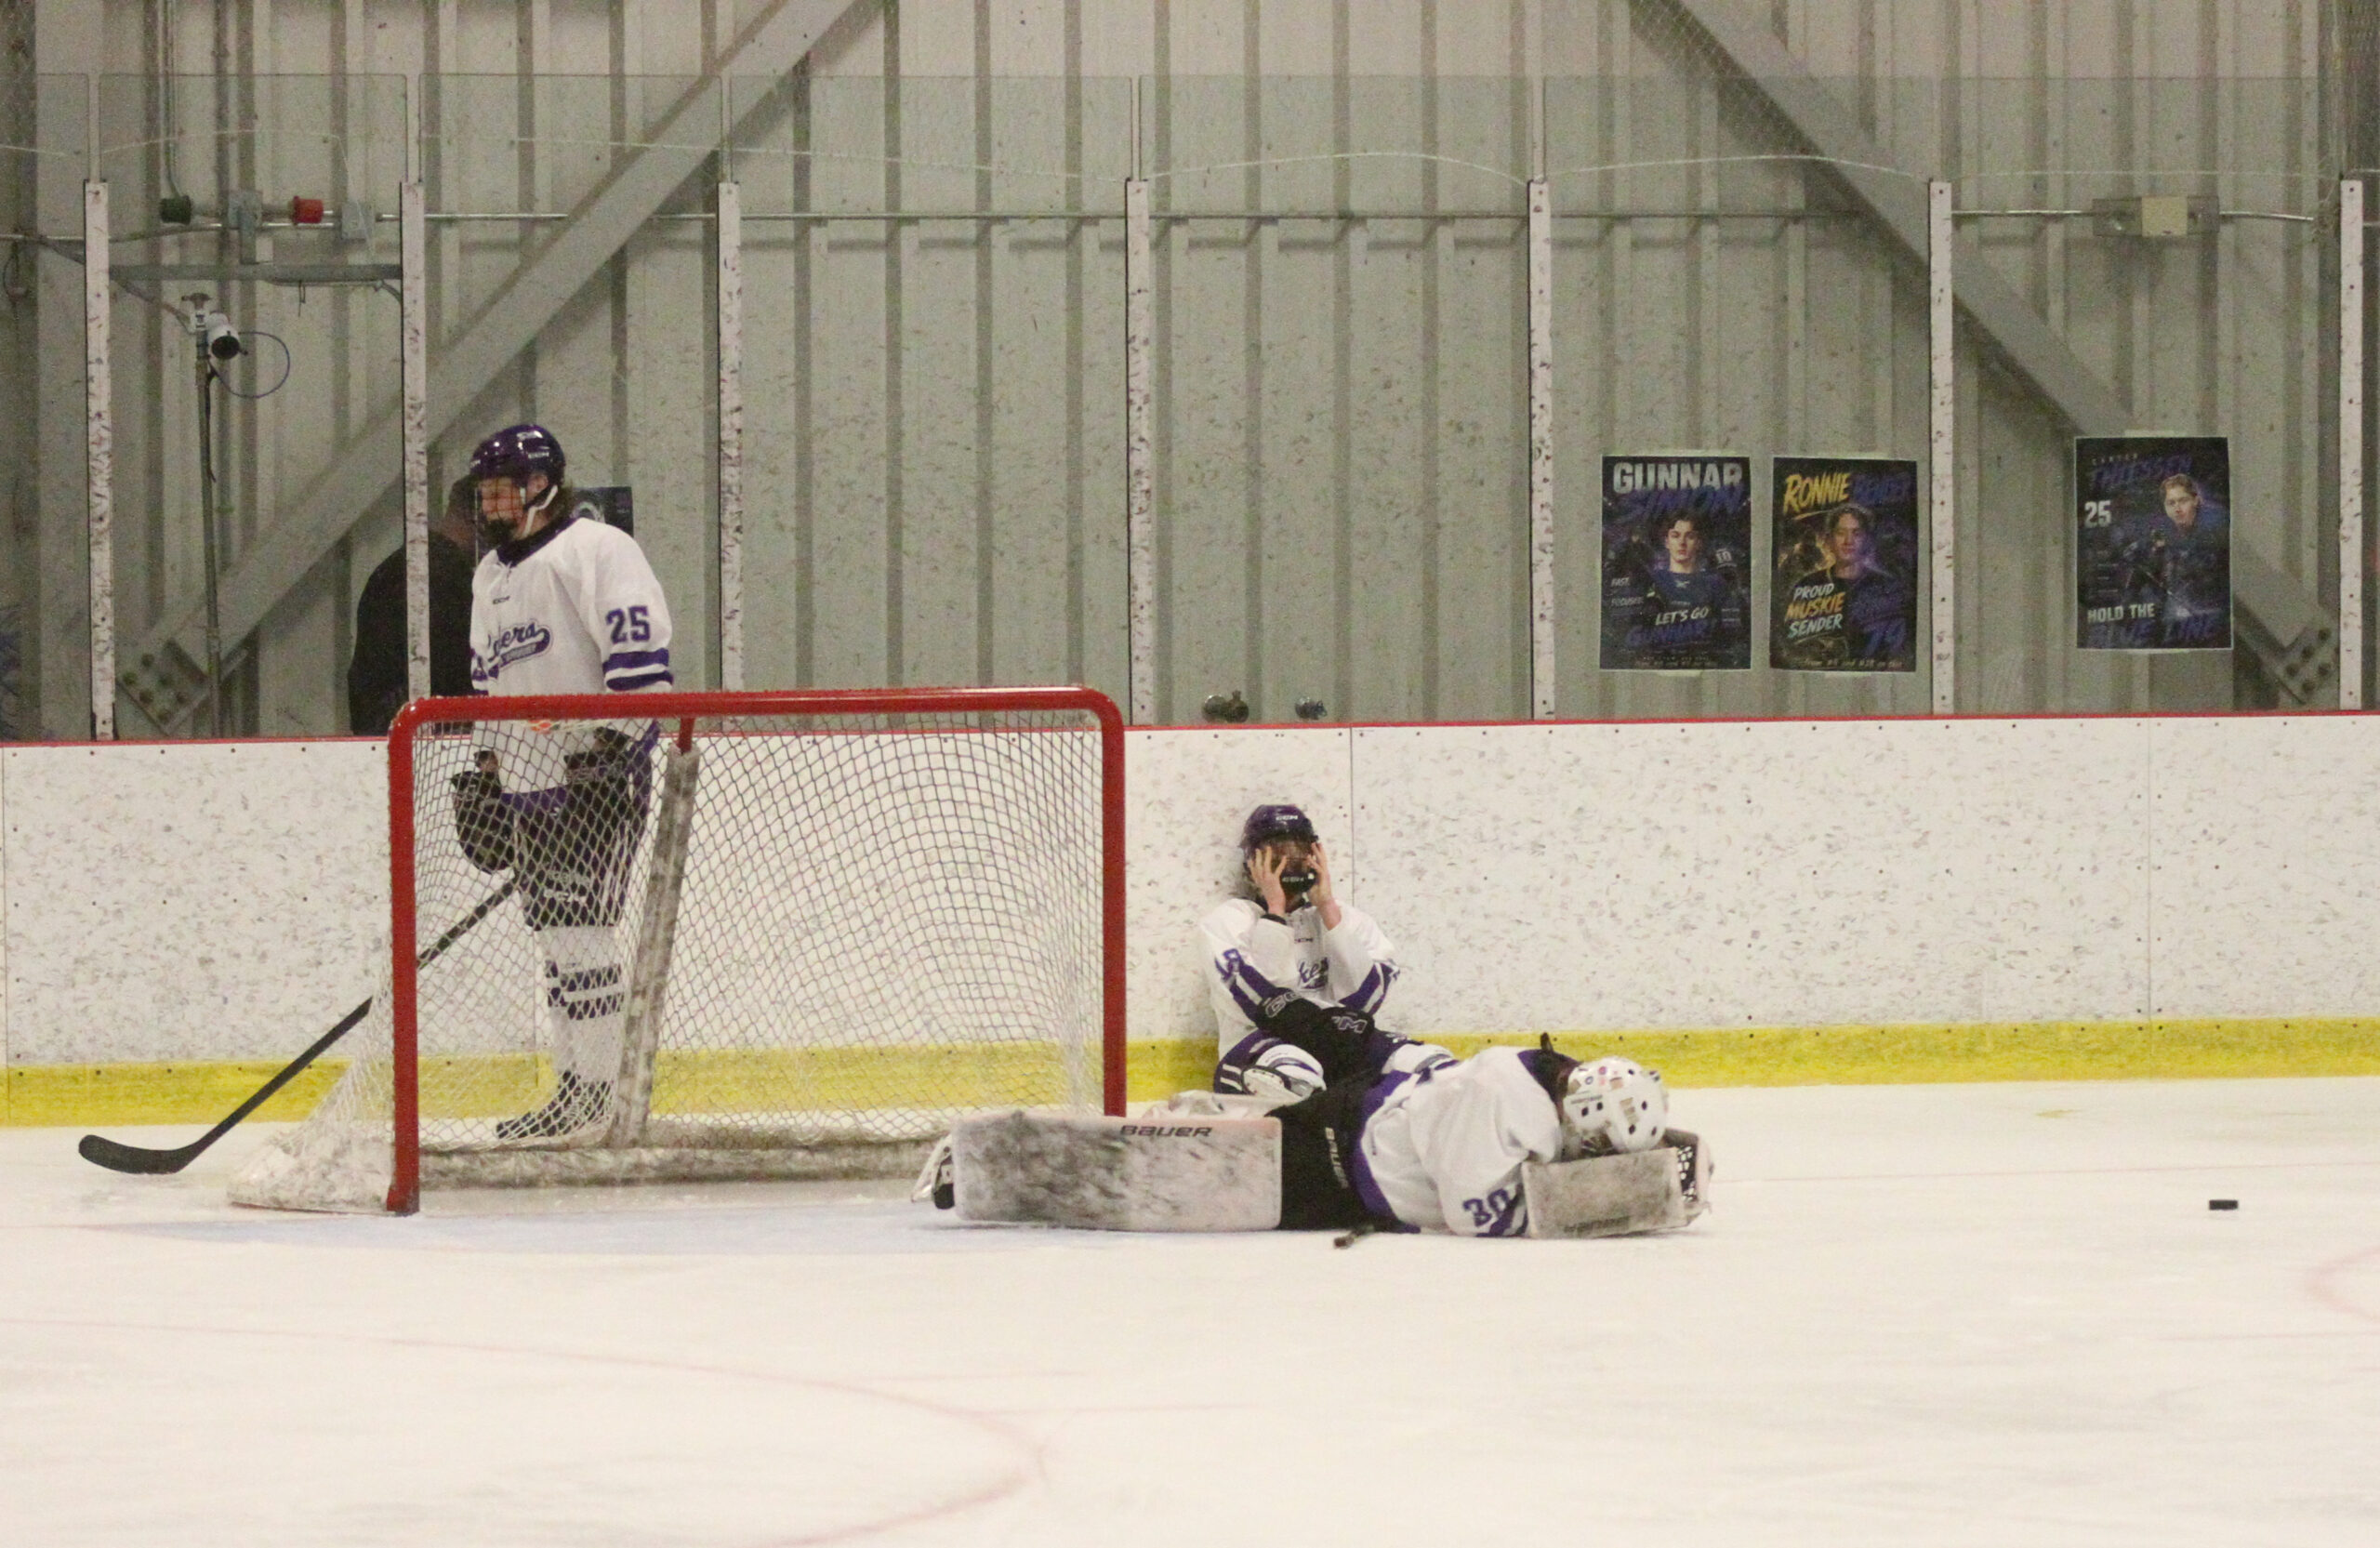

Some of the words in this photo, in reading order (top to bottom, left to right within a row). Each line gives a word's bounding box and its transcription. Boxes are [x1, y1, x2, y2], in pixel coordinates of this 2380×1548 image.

[1613, 461, 1744, 494] GUNNAR
[1783, 472, 1851, 514] RONNIE
[2083, 499, 2112, 527] 25
[1793, 583, 1834, 602] PROUD
[1655, 608, 1689, 626] LET'S
[1690, 607, 1710, 621] GO
[1785, 591, 1845, 623] MUSKIE
[2087, 605, 2123, 623] HOLD
[2128, 602, 2155, 619] THE
[606, 605, 651, 643] 25
[1787, 613, 1843, 639] SENDER
[1119, 1125, 1213, 1137] BAUER
[1462, 1188, 1510, 1227] 30
